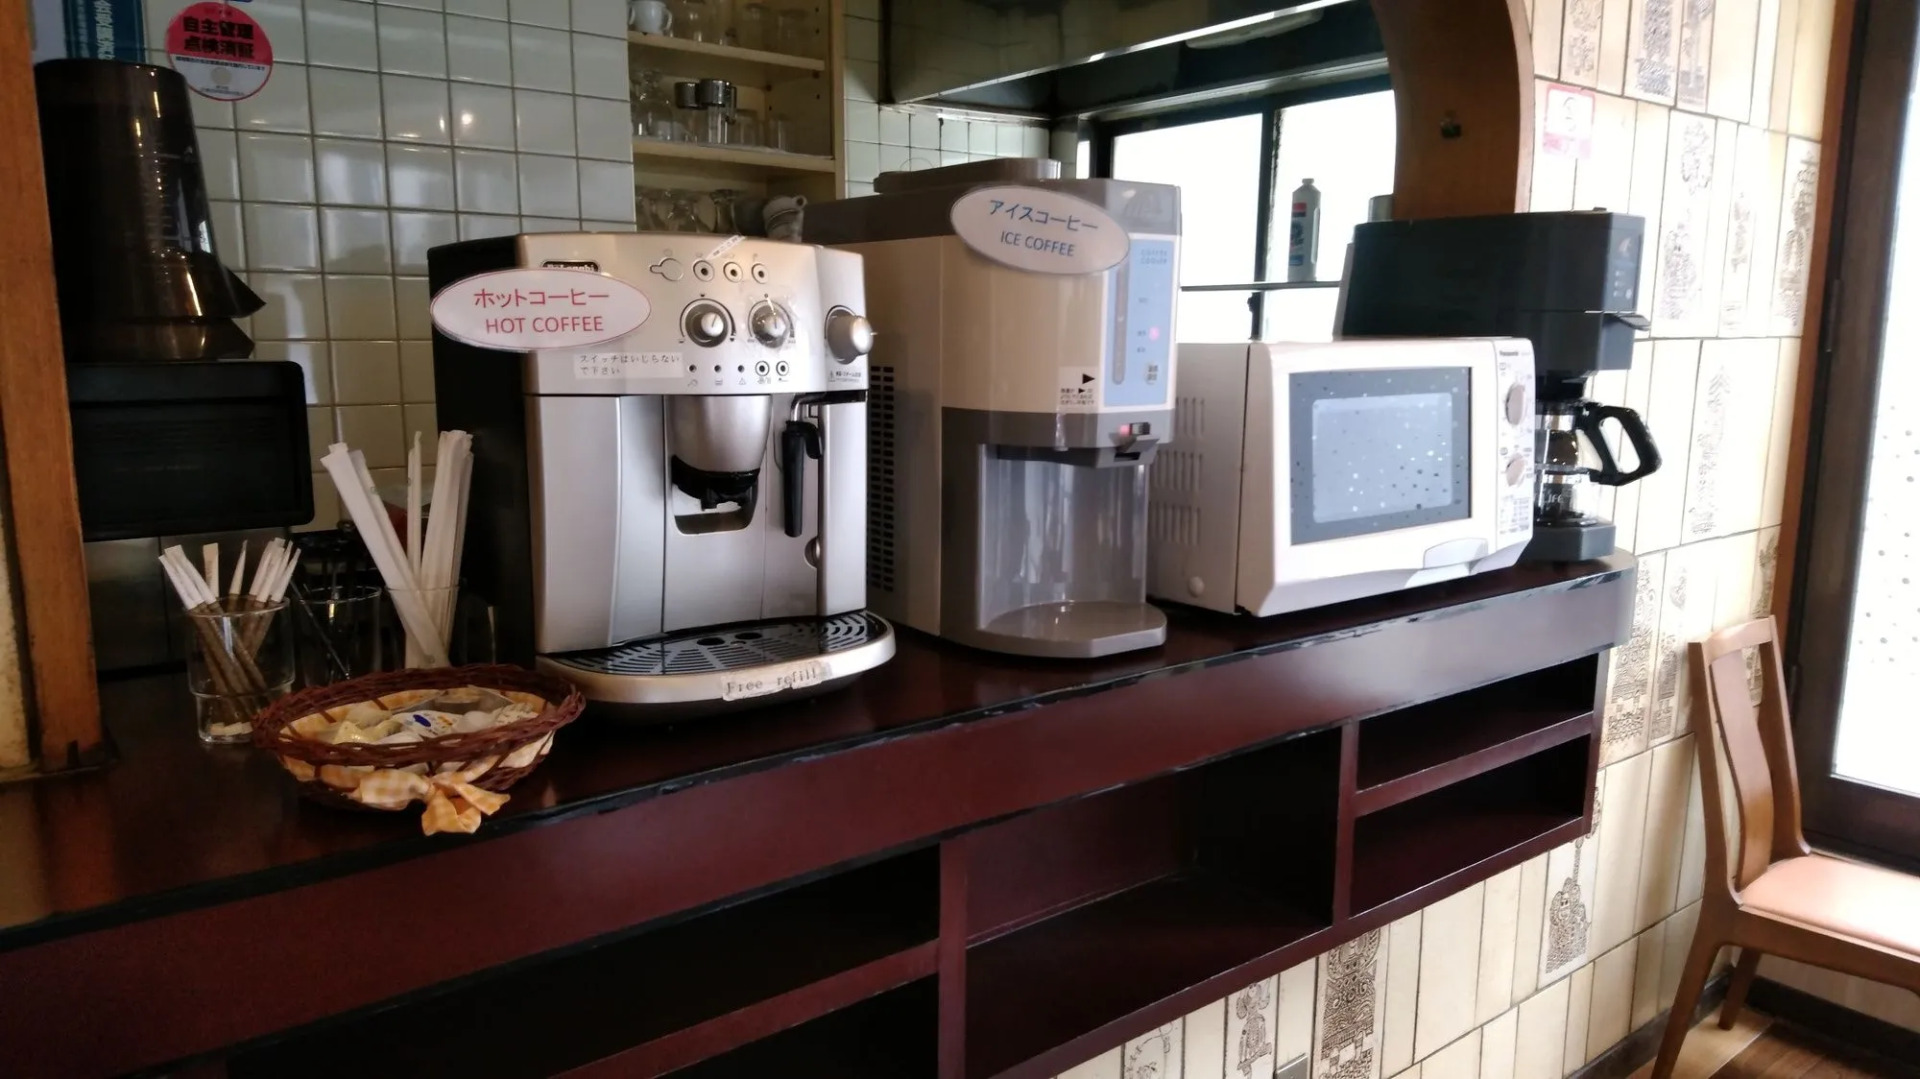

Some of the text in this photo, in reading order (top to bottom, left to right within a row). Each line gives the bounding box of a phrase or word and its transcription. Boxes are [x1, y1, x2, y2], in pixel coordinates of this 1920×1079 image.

[989, 199, 1099, 232] アイスコーヒー
[1000, 230, 1076, 257] ICE COFFEE
[473, 288, 610, 309] ホットコーヒー
[485, 315, 605, 334] HOT COFFEE
[579, 354, 681, 364] スイッチはいじらない
[580, 366, 621, 376] で下さい
[726, 667, 817, 694] Free refill
